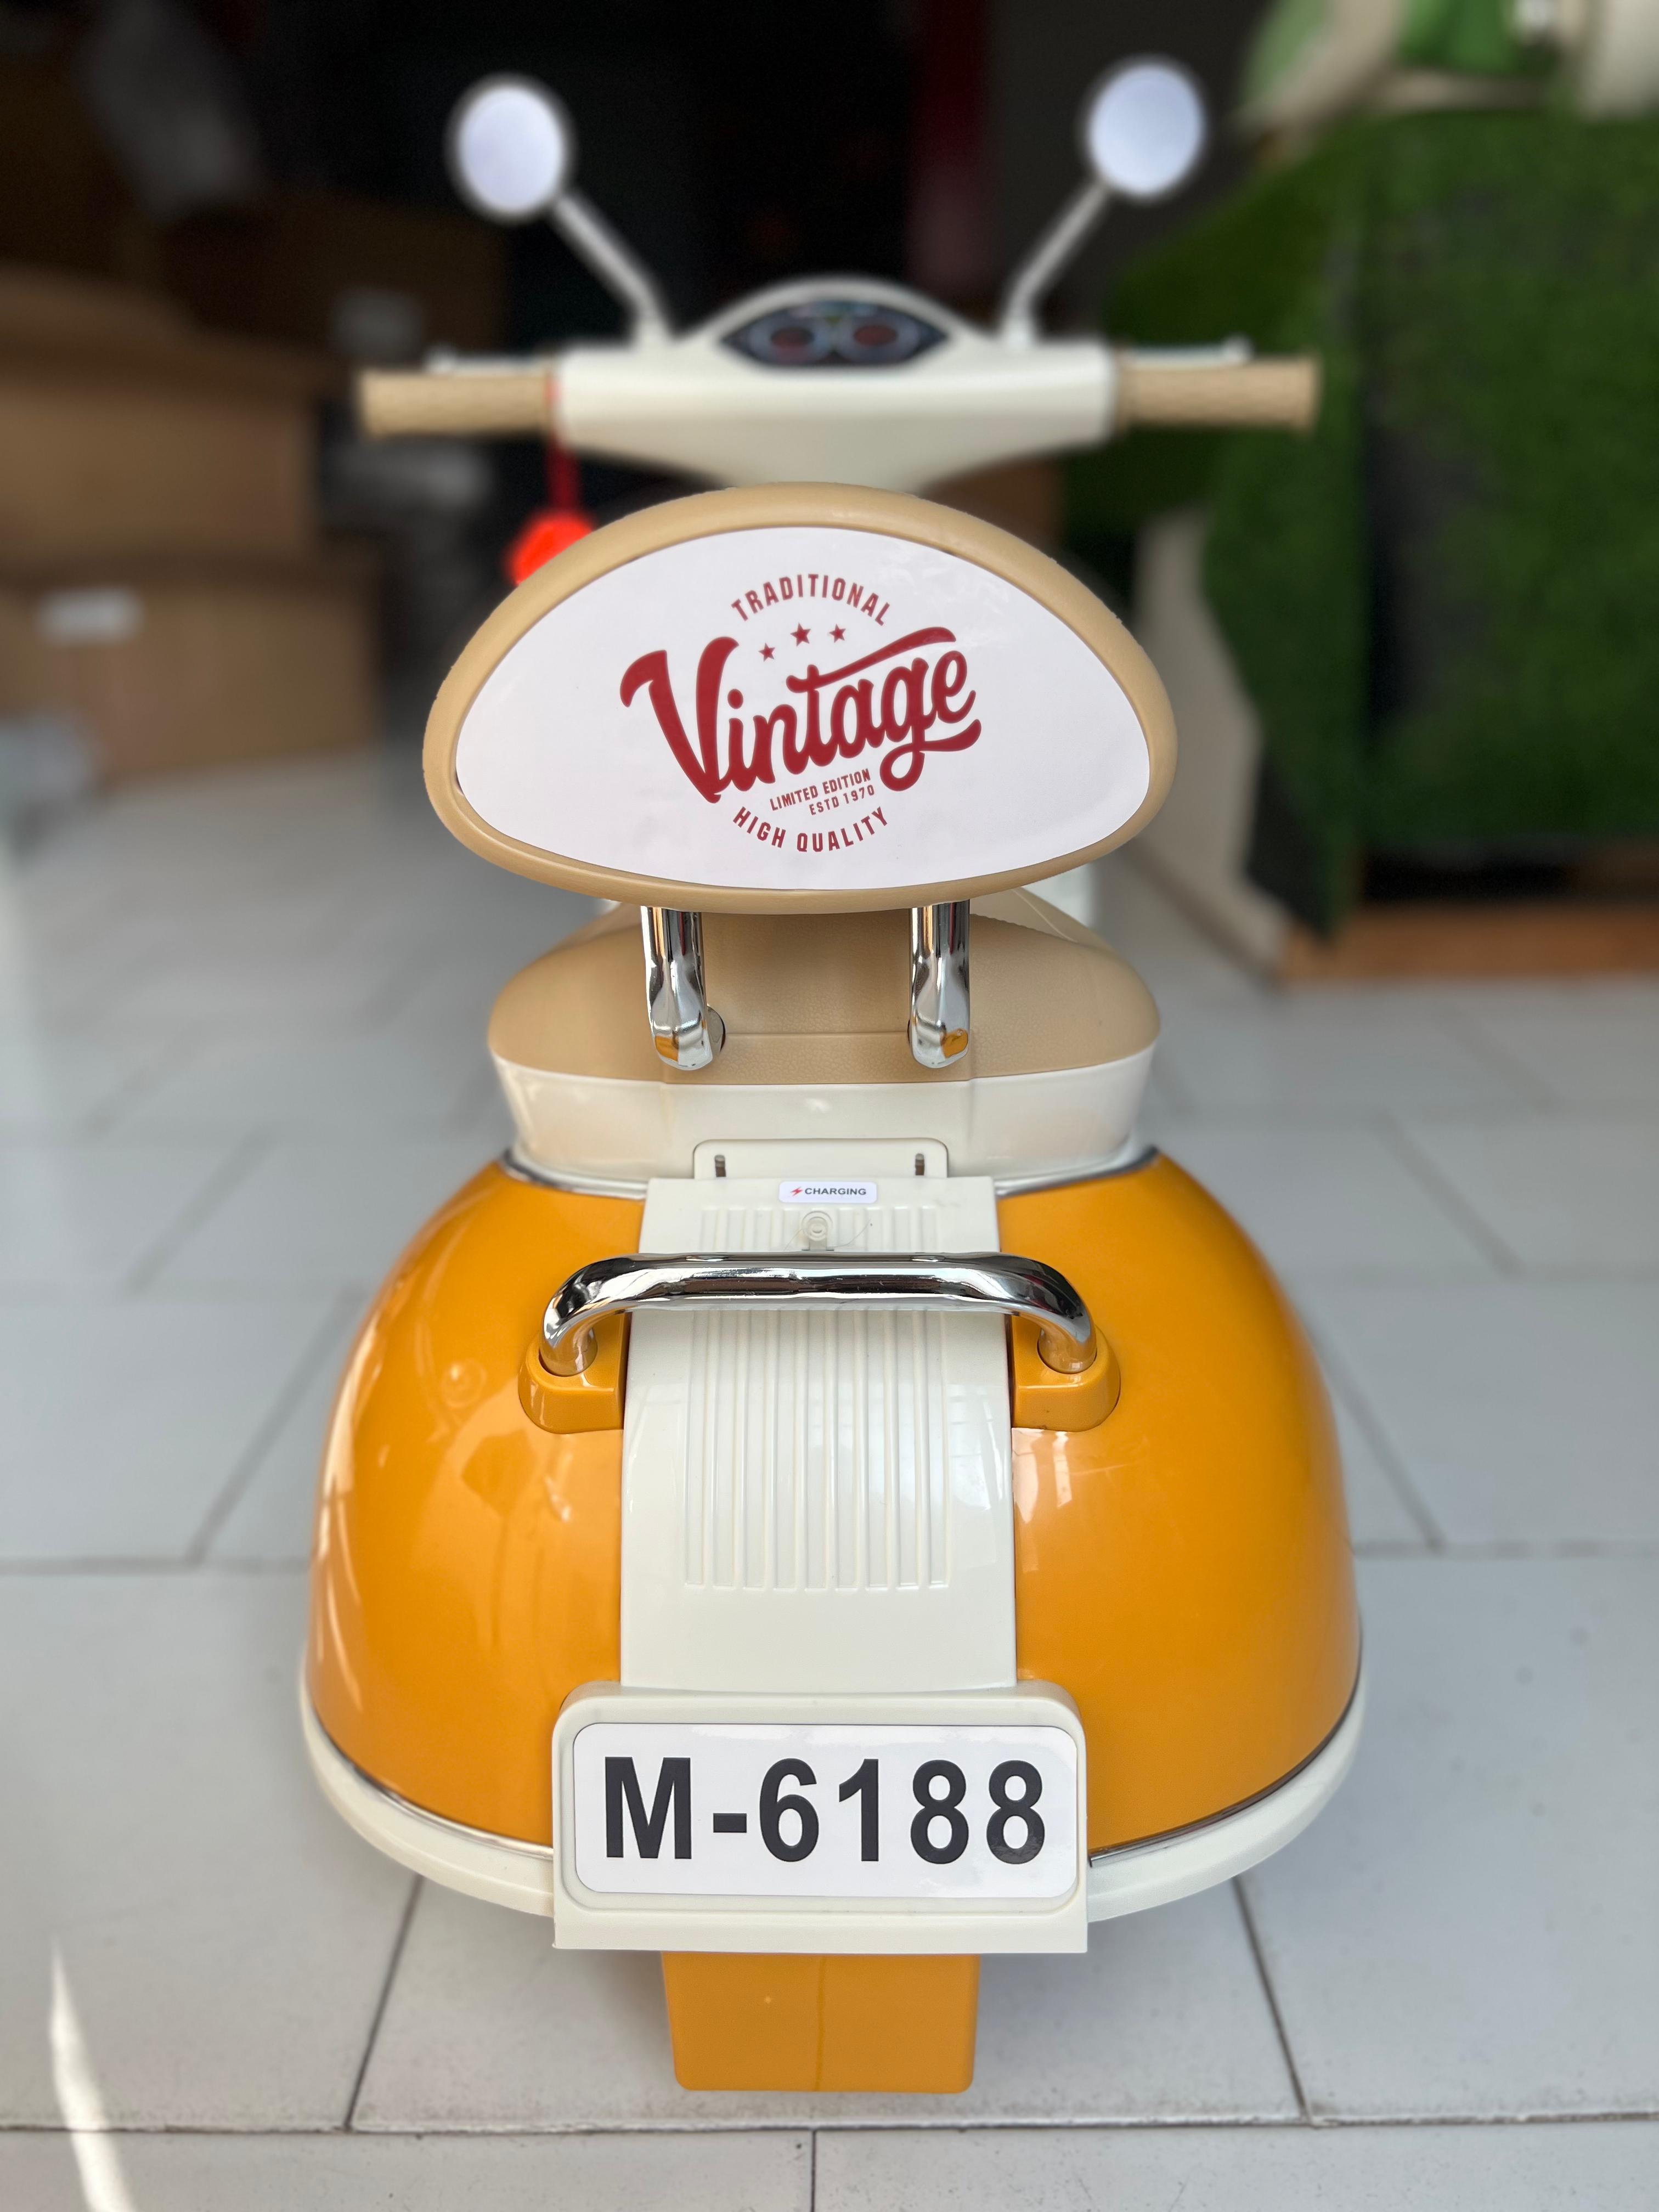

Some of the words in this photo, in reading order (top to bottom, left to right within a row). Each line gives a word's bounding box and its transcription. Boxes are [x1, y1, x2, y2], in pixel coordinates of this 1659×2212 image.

[731, 573, 890, 626] TRADITIONAL
[620, 627, 981, 804] Vintage
[770, 785, 818, 811] LIMITED
[822, 768, 871, 794] EDITION
[808, 798, 840, 816] ESTD
[844, 785, 875, 806] 1970
[732, 806, 786, 849] HIGH
[797, 806, 888, 853] QUALITY
[605, 1756, 1046, 1865] M-6188
